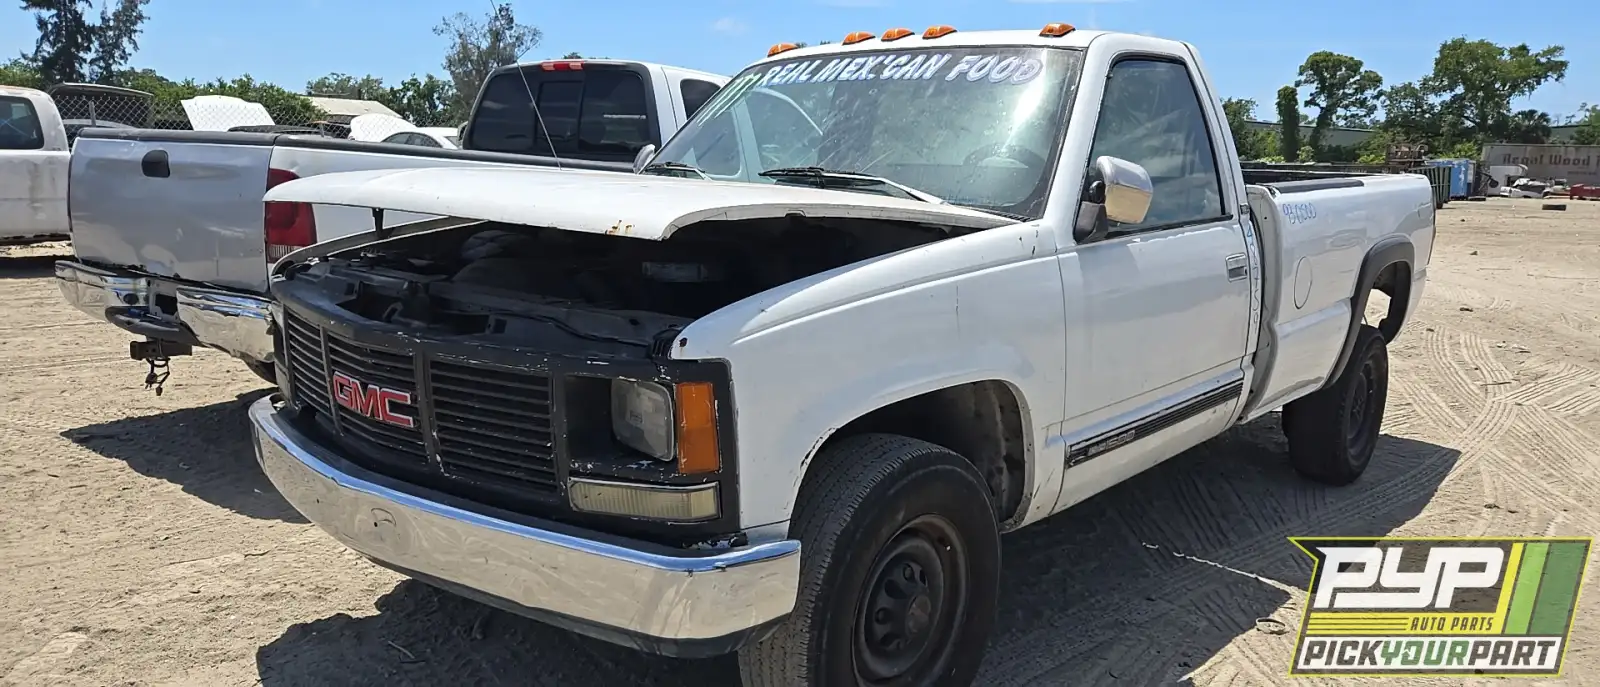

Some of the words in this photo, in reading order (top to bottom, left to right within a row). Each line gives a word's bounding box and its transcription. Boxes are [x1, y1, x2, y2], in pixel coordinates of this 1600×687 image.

[755, 59, 823, 88] REAL
[945, 54, 1043, 85] FOOD
[1549, 154, 1590, 166] Wood
[333, 371, 414, 428] GMC
